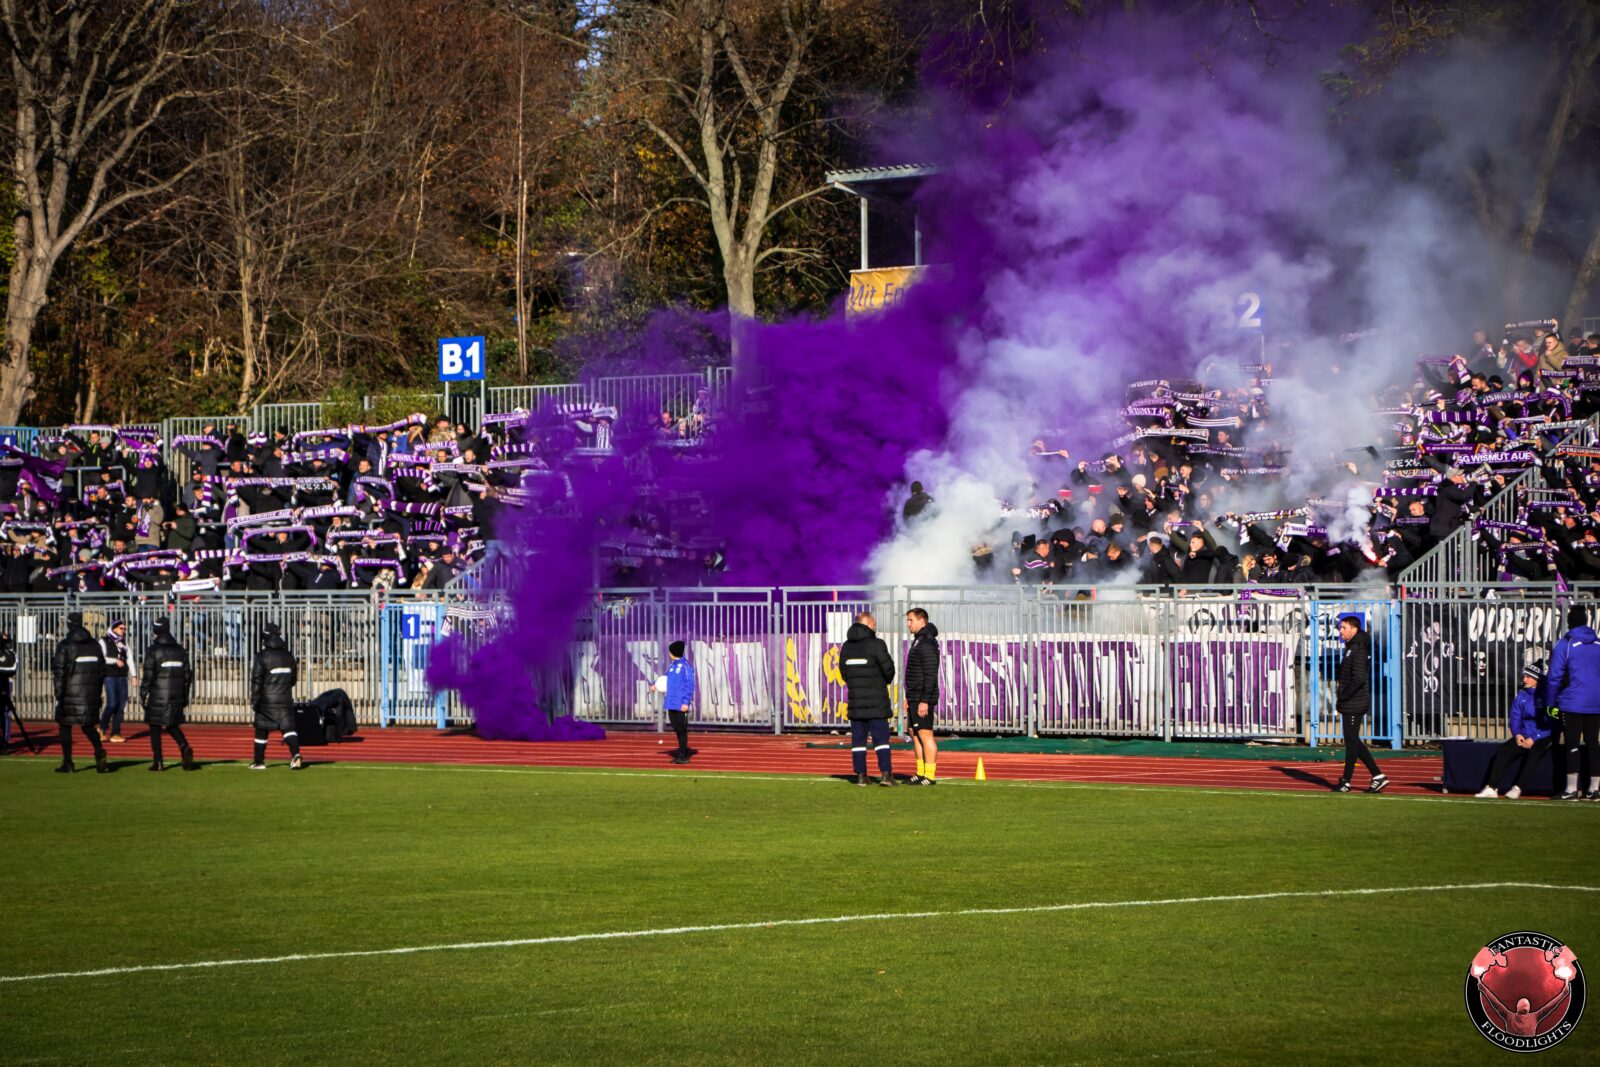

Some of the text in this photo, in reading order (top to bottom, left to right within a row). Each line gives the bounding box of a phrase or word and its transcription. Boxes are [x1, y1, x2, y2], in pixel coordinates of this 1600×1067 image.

[442, 341, 480, 375] B1
[1470, 453, 1510, 463] WISMUT
[1511, 451, 1532, 460] AUE
[407, 616, 415, 637] 1
